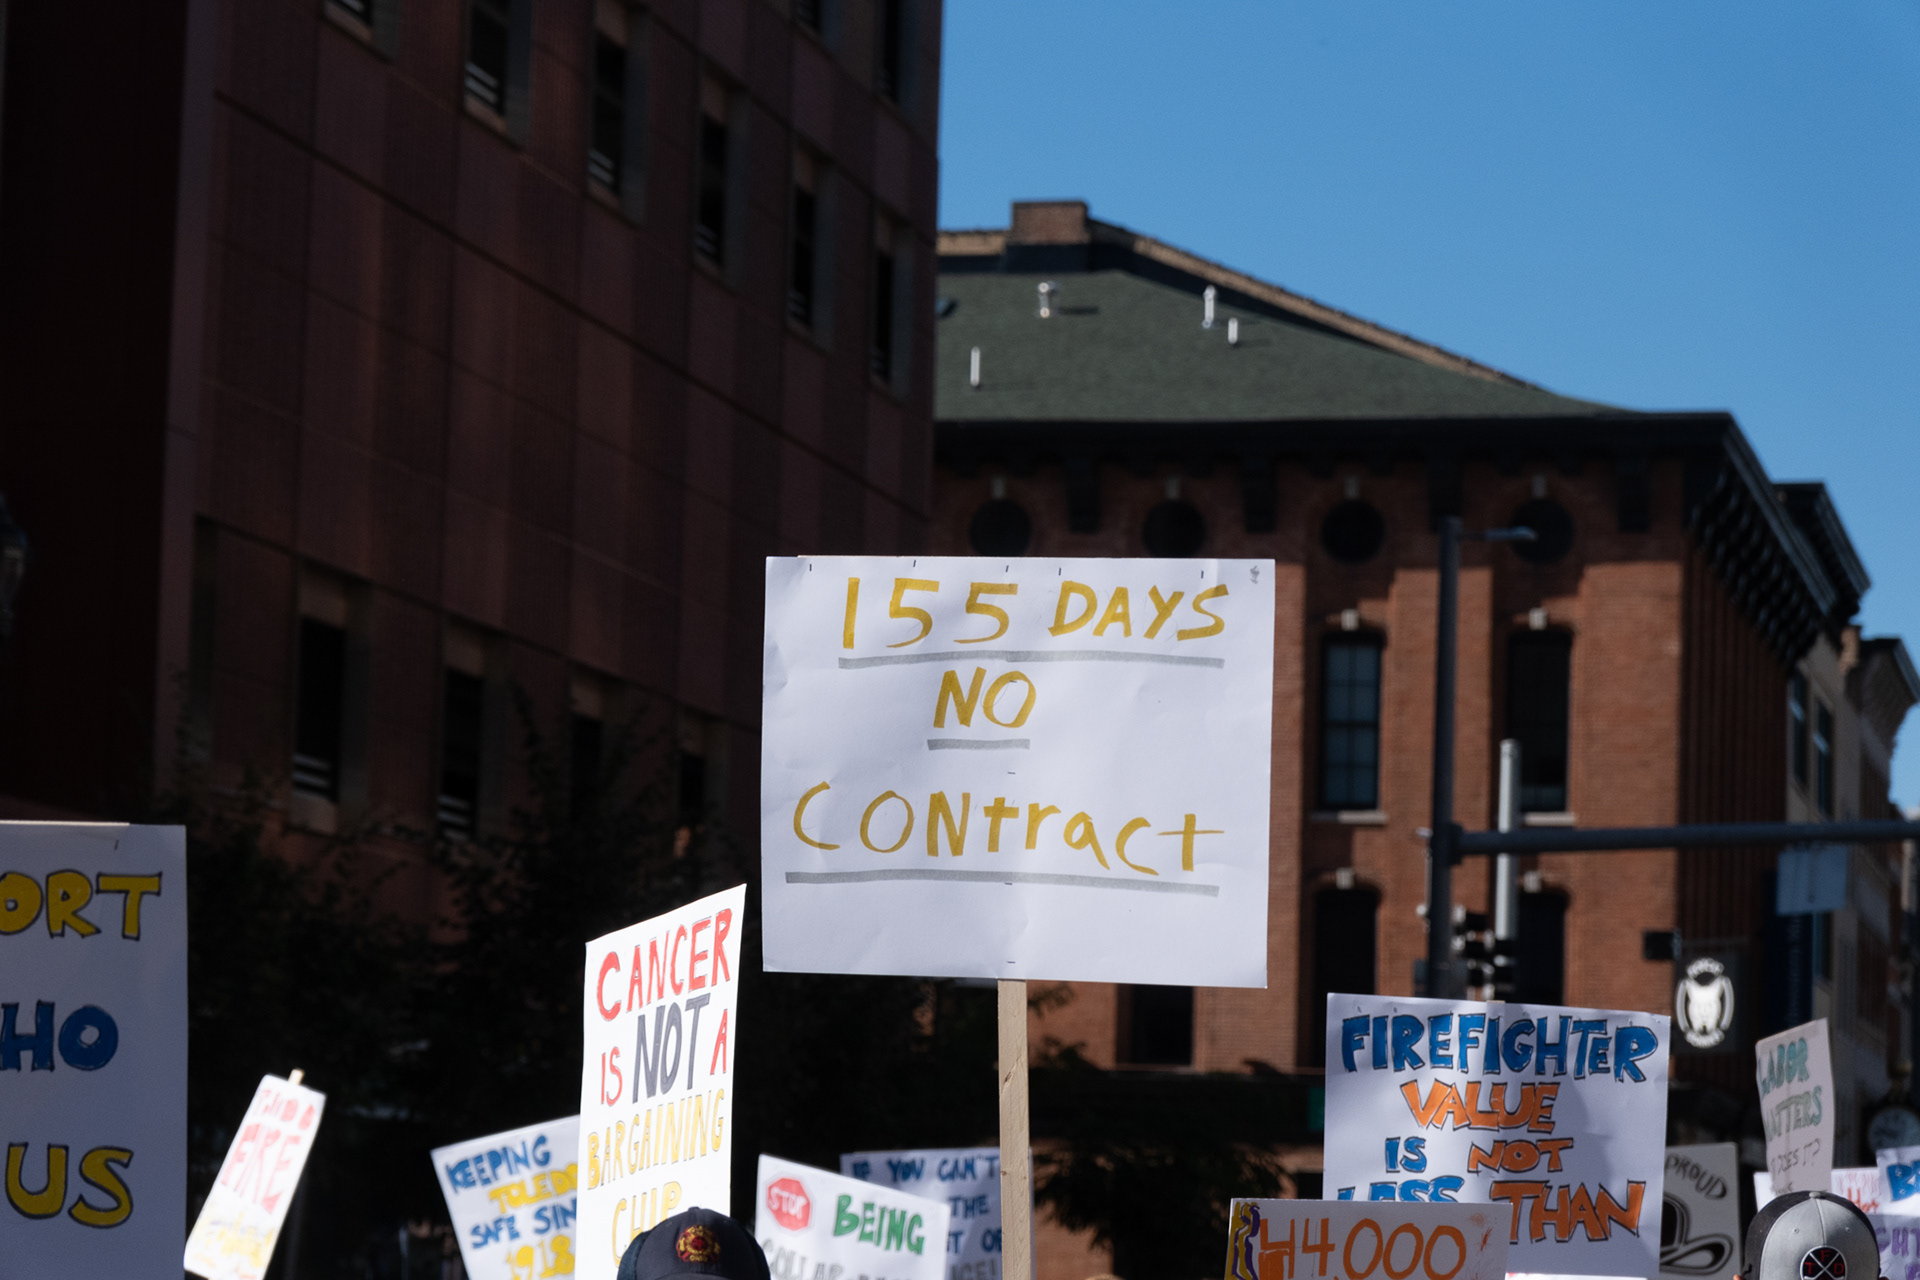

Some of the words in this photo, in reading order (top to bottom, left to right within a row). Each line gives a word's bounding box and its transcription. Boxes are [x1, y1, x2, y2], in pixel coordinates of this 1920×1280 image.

[843, 577, 1018, 648] 155
[1048, 581, 1228, 641] DAYS
[933, 667, 1036, 728] NO
[597, 908, 732, 1021] CANCER
[601, 1046, 622, 1106] IS
[632, 993, 710, 1103] NOT
[710, 1009, 728, 1075] A
[1341, 1013, 1658, 1082] FIREFIGHTER
[1400, 1079, 1561, 1133] VALUE
[446, 1135, 551, 1194] KEEPING
[587, 1088, 724, 1190] BARGAINING
[887, 1158, 924, 1182] YOU
[1385, 1137, 1427, 1173] IS
[1467, 1138, 1573, 1173] NOT
[5, 1142, 134, 1228] US
[1665, 1154, 1727, 1199] PROUD
[471, 1215, 520, 1249] SAFE
[769, 1187, 807, 1220] STOP
[833, 1195, 925, 1255] BEING
[1489, 1180, 1646, 1244] THAN
